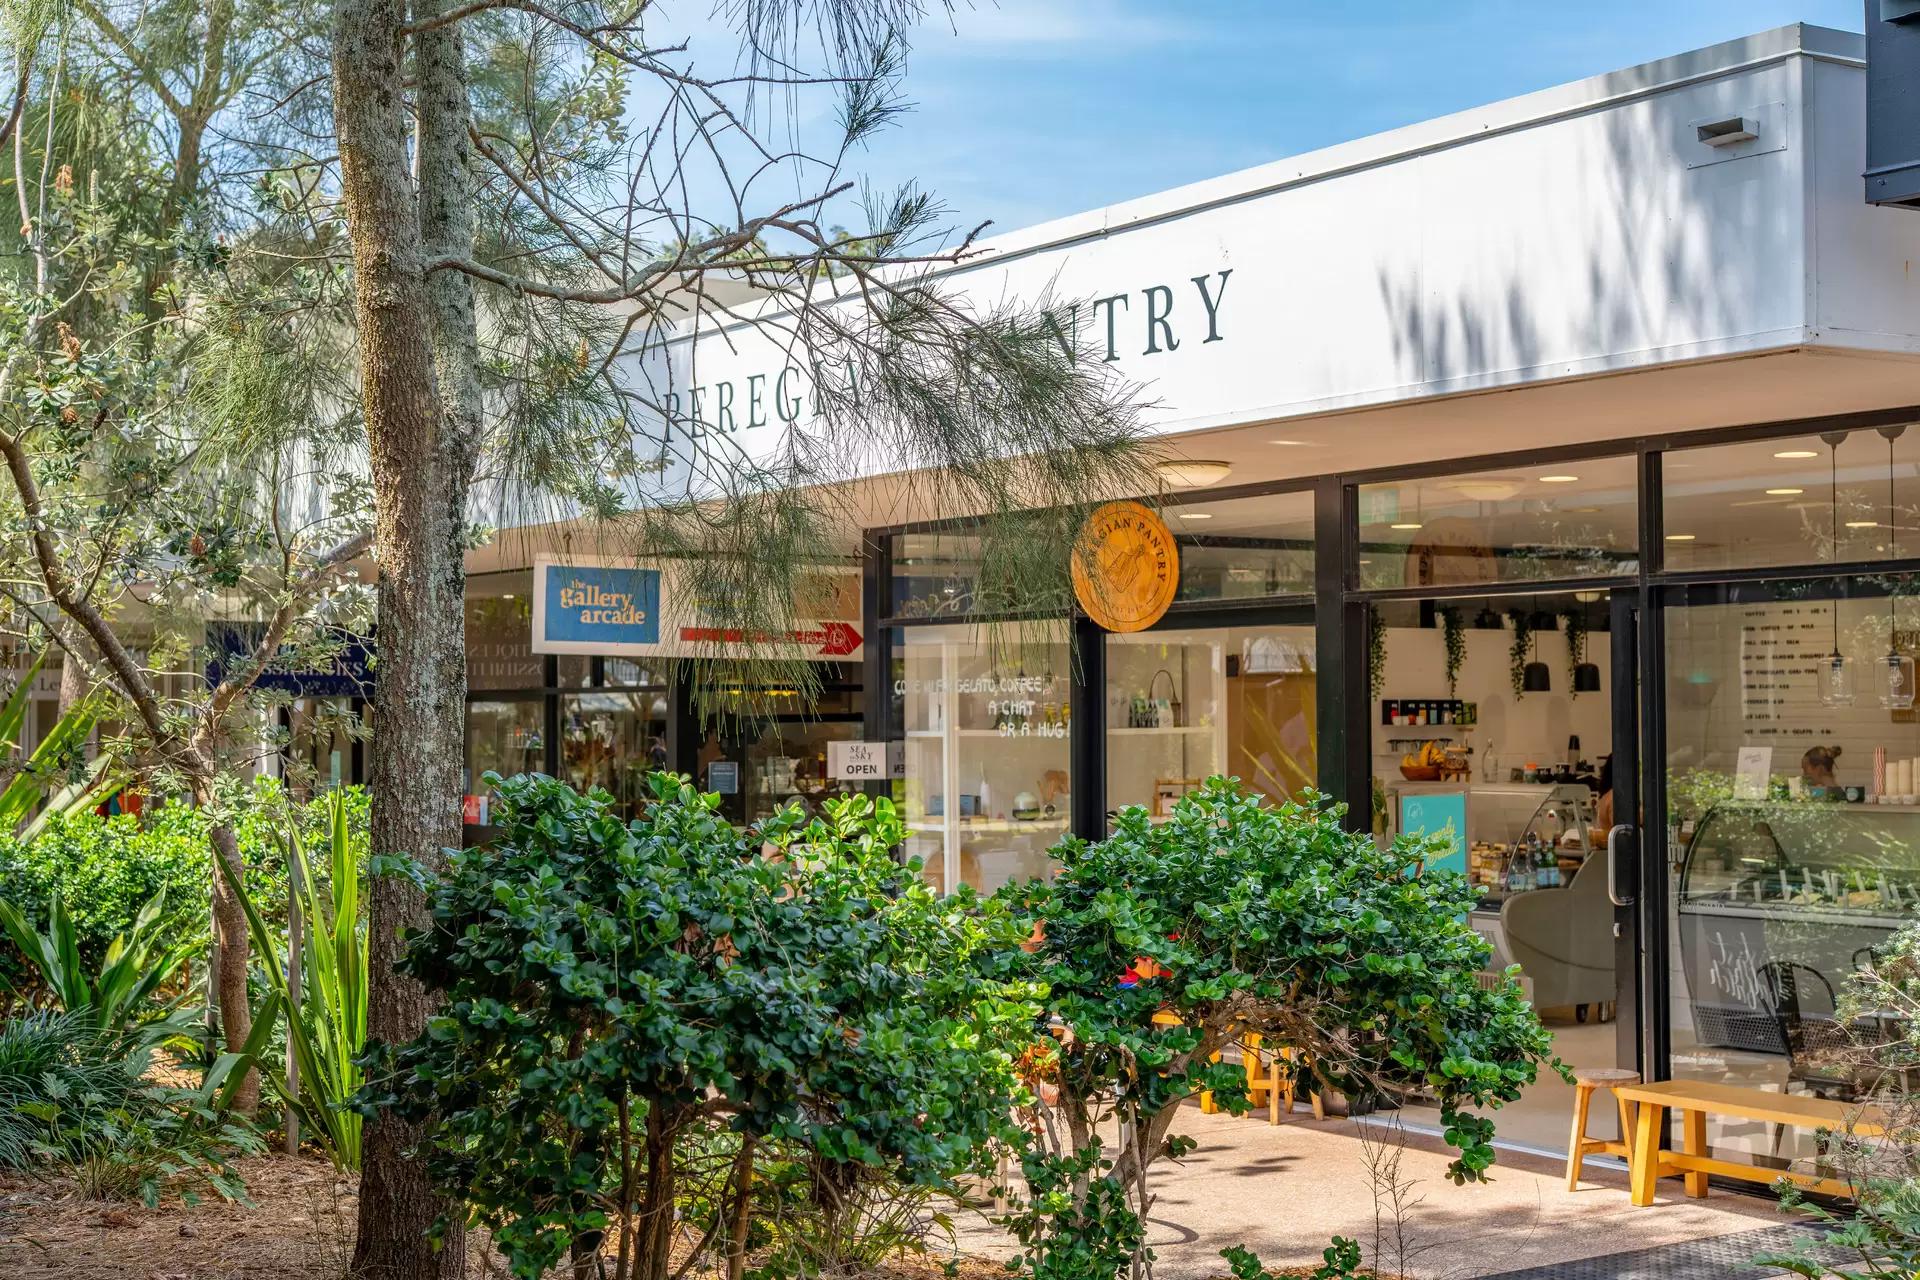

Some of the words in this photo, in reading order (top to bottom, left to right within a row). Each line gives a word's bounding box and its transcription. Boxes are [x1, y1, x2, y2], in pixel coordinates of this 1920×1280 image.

[662, 347, 866, 443] PEREGIA
[1096, 518, 1131, 540] GIAN
[1136, 521, 1167, 582] PANTRY
[560, 585, 633, 612] gallery
[580, 605, 646, 625] arcade
[988, 700, 998, 716] A
[1001, 700, 1036, 716] CHAT
[998, 721, 1016, 739] OR
[1020, 721, 1031, 737] A
[849, 745, 868, 754] SEA
[855, 752, 873, 761] SKY
[846, 764, 878, 775] OPEN
